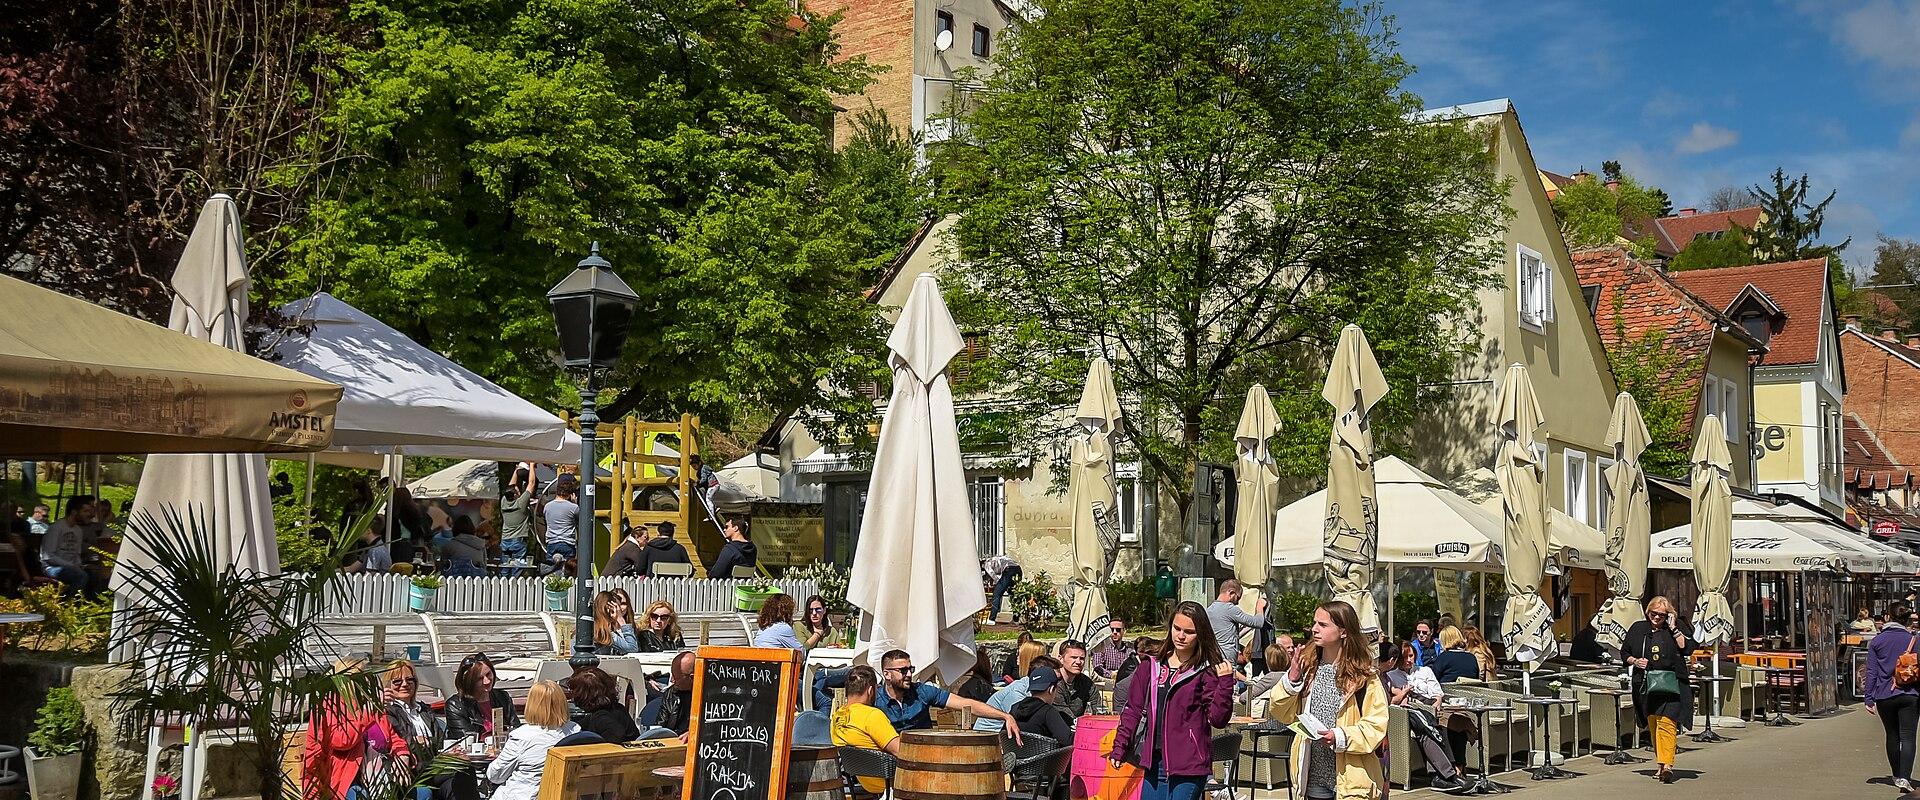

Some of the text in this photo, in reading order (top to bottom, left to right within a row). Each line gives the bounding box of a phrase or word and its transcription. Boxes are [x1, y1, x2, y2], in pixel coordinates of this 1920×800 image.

[268, 411, 325, 432] AMSTEL
[710, 662, 772, 684] RAKHIA BAR
[704, 702, 744, 720] HAPPY
[720, 724, 769, 742] HOUR(S)
